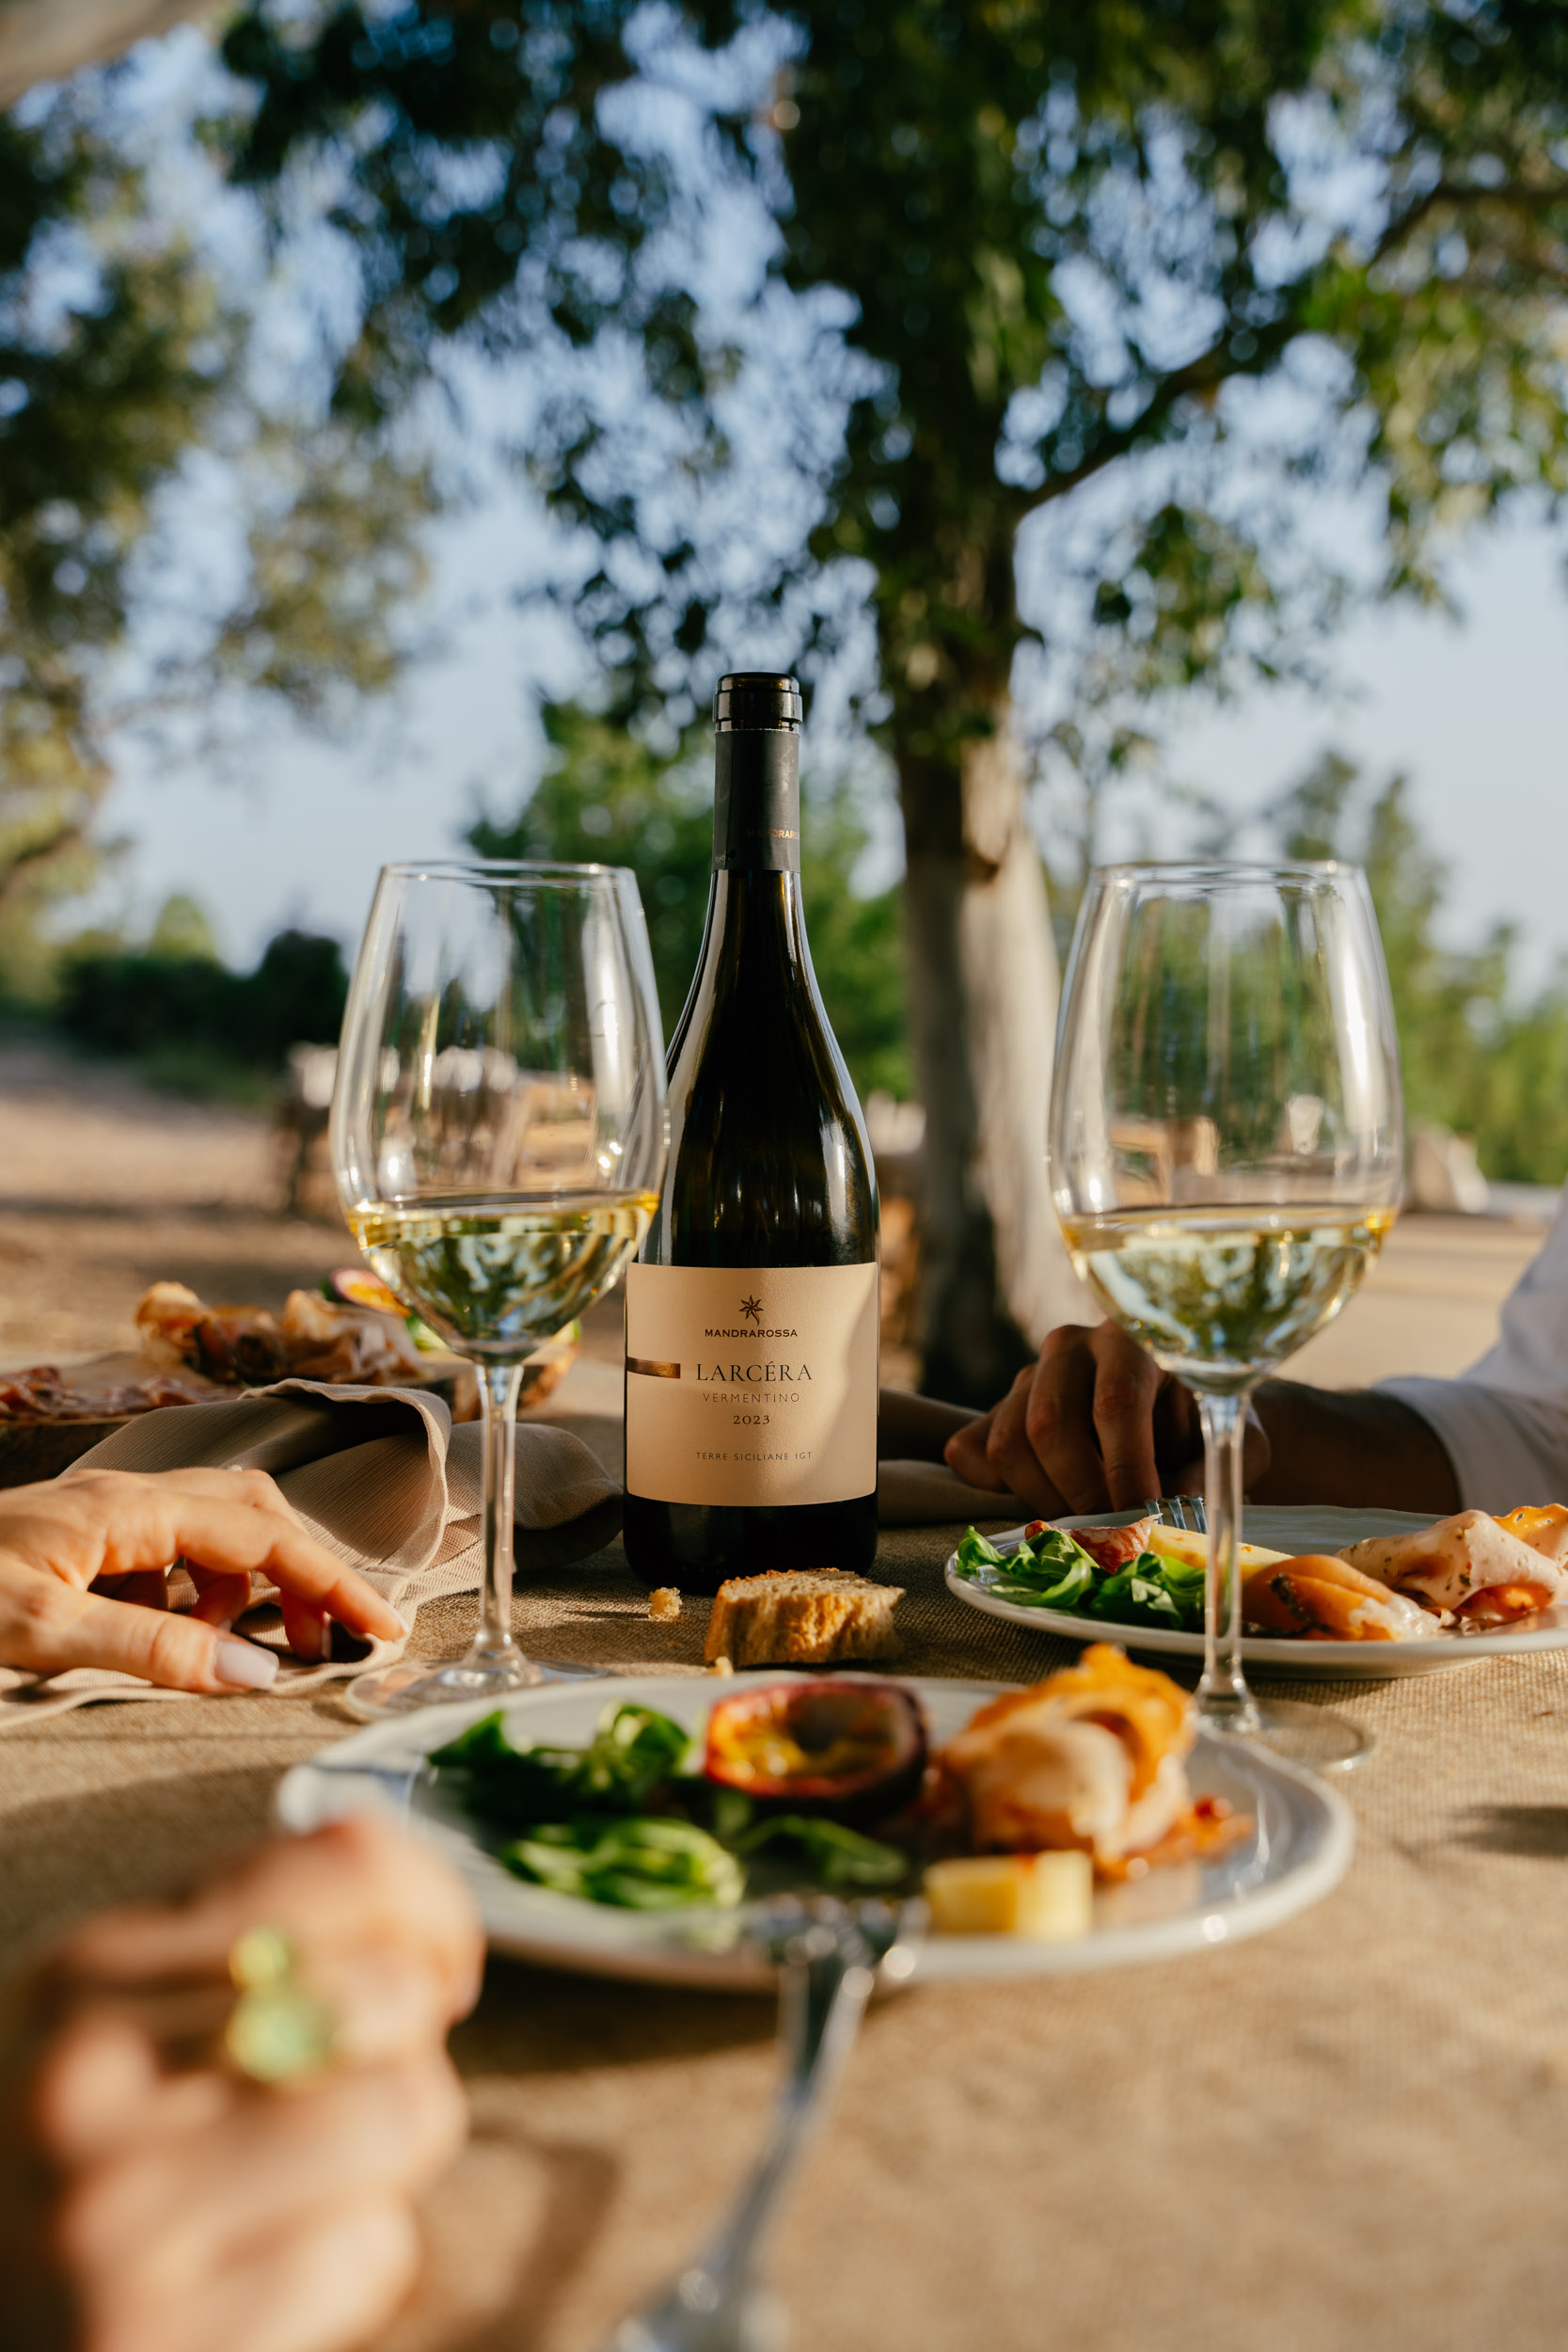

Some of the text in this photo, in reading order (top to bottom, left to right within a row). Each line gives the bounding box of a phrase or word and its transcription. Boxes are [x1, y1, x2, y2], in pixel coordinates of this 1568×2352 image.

[705, 1328, 799, 1338] MANDRAROSSA
[696, 1360, 813, 1382] LARCÉRA
[703, 1392, 800, 1404] VERMENTINO
[733, 1414, 770, 1425] 2023
[696, 1452, 812, 1461] TERRE SICILIANE IGT
